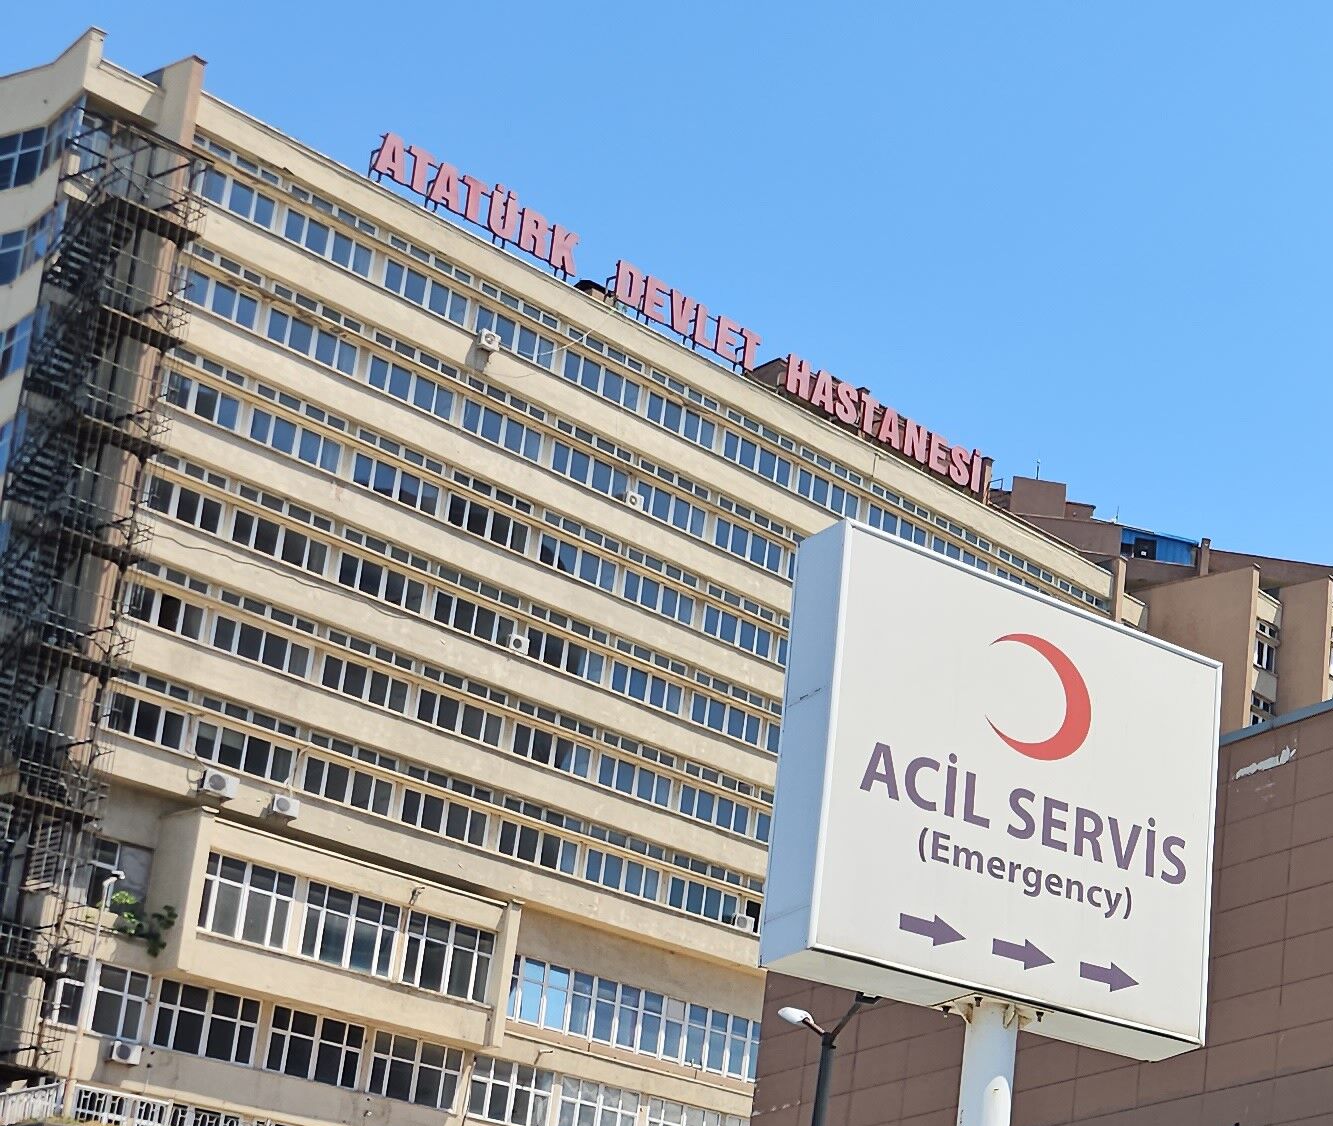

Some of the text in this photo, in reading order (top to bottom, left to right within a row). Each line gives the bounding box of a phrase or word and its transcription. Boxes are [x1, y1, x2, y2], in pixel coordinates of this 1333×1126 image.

[375, 132, 984, 496] ATATÜRK DEVLET HASTANESİ
[859, 741, 1188, 886] ACİL SERVİS
[917, 826, 1133, 920] (Emergency)
